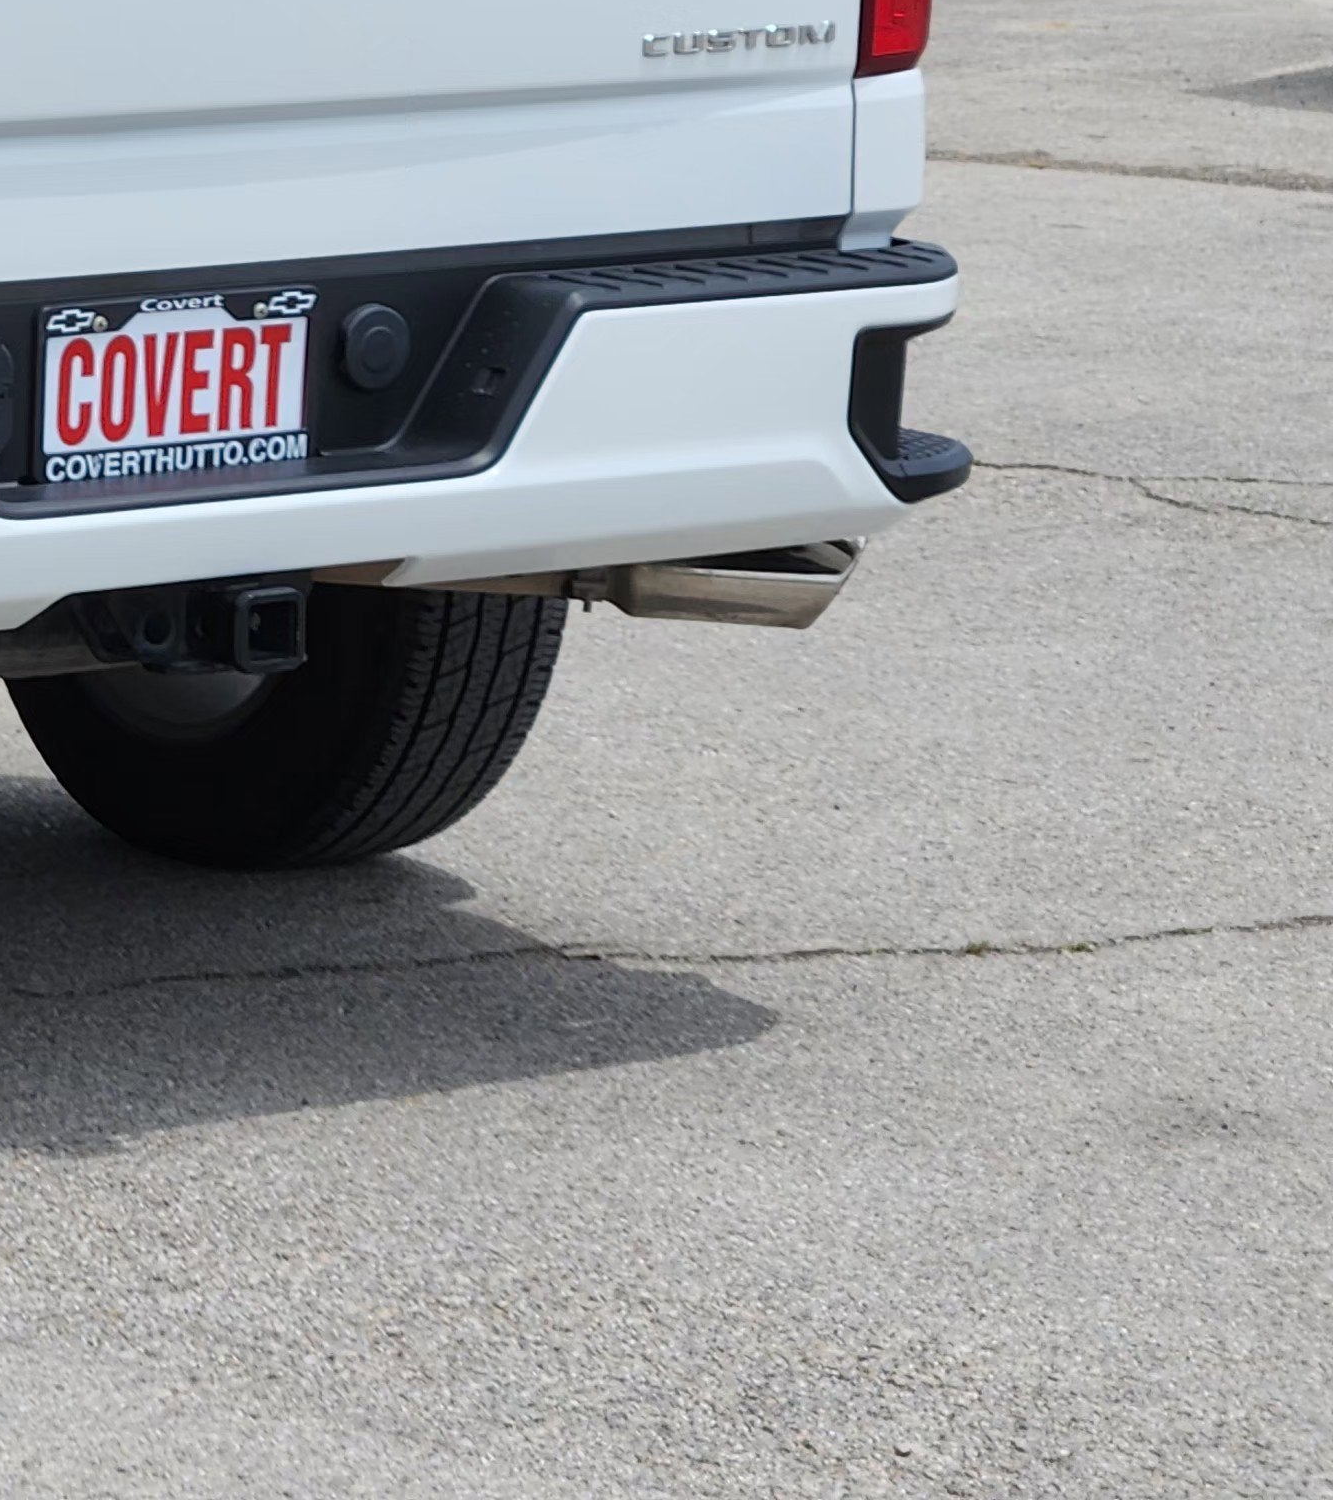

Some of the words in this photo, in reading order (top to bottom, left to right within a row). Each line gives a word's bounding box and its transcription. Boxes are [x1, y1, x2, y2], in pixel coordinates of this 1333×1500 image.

[642, 20, 835, 58] CUSTOM
[140, 294, 225, 313] Covert
[56, 323, 292, 446] COVERT
[45, 434, 308, 483] COVERTHUTTO.COM
